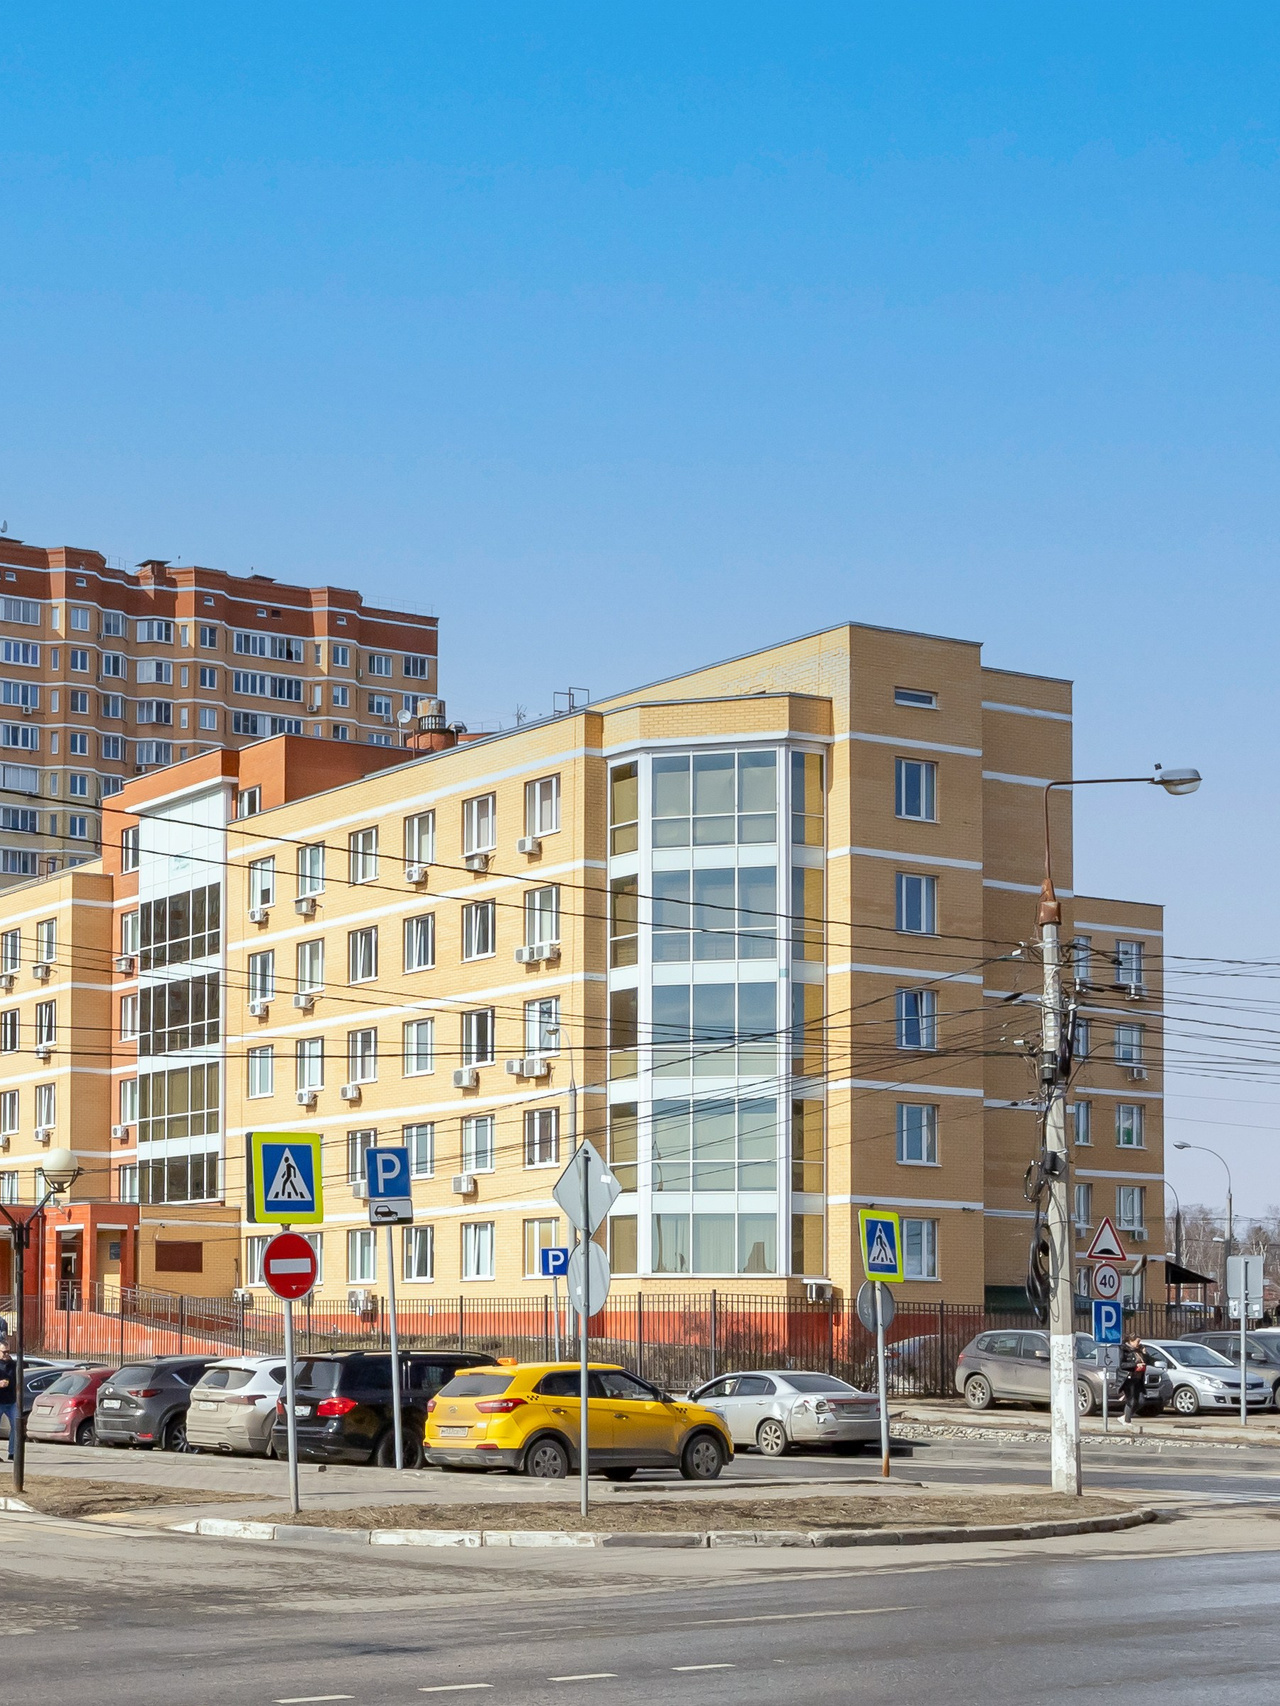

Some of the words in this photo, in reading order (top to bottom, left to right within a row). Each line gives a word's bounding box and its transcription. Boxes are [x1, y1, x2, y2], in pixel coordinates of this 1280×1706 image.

[376, 1153, 401, 1193] P
[548, 1250, 565, 1274] P
[1099, 1274, 1116, 1289] 40
[1101, 1305, 1117, 1339] P
